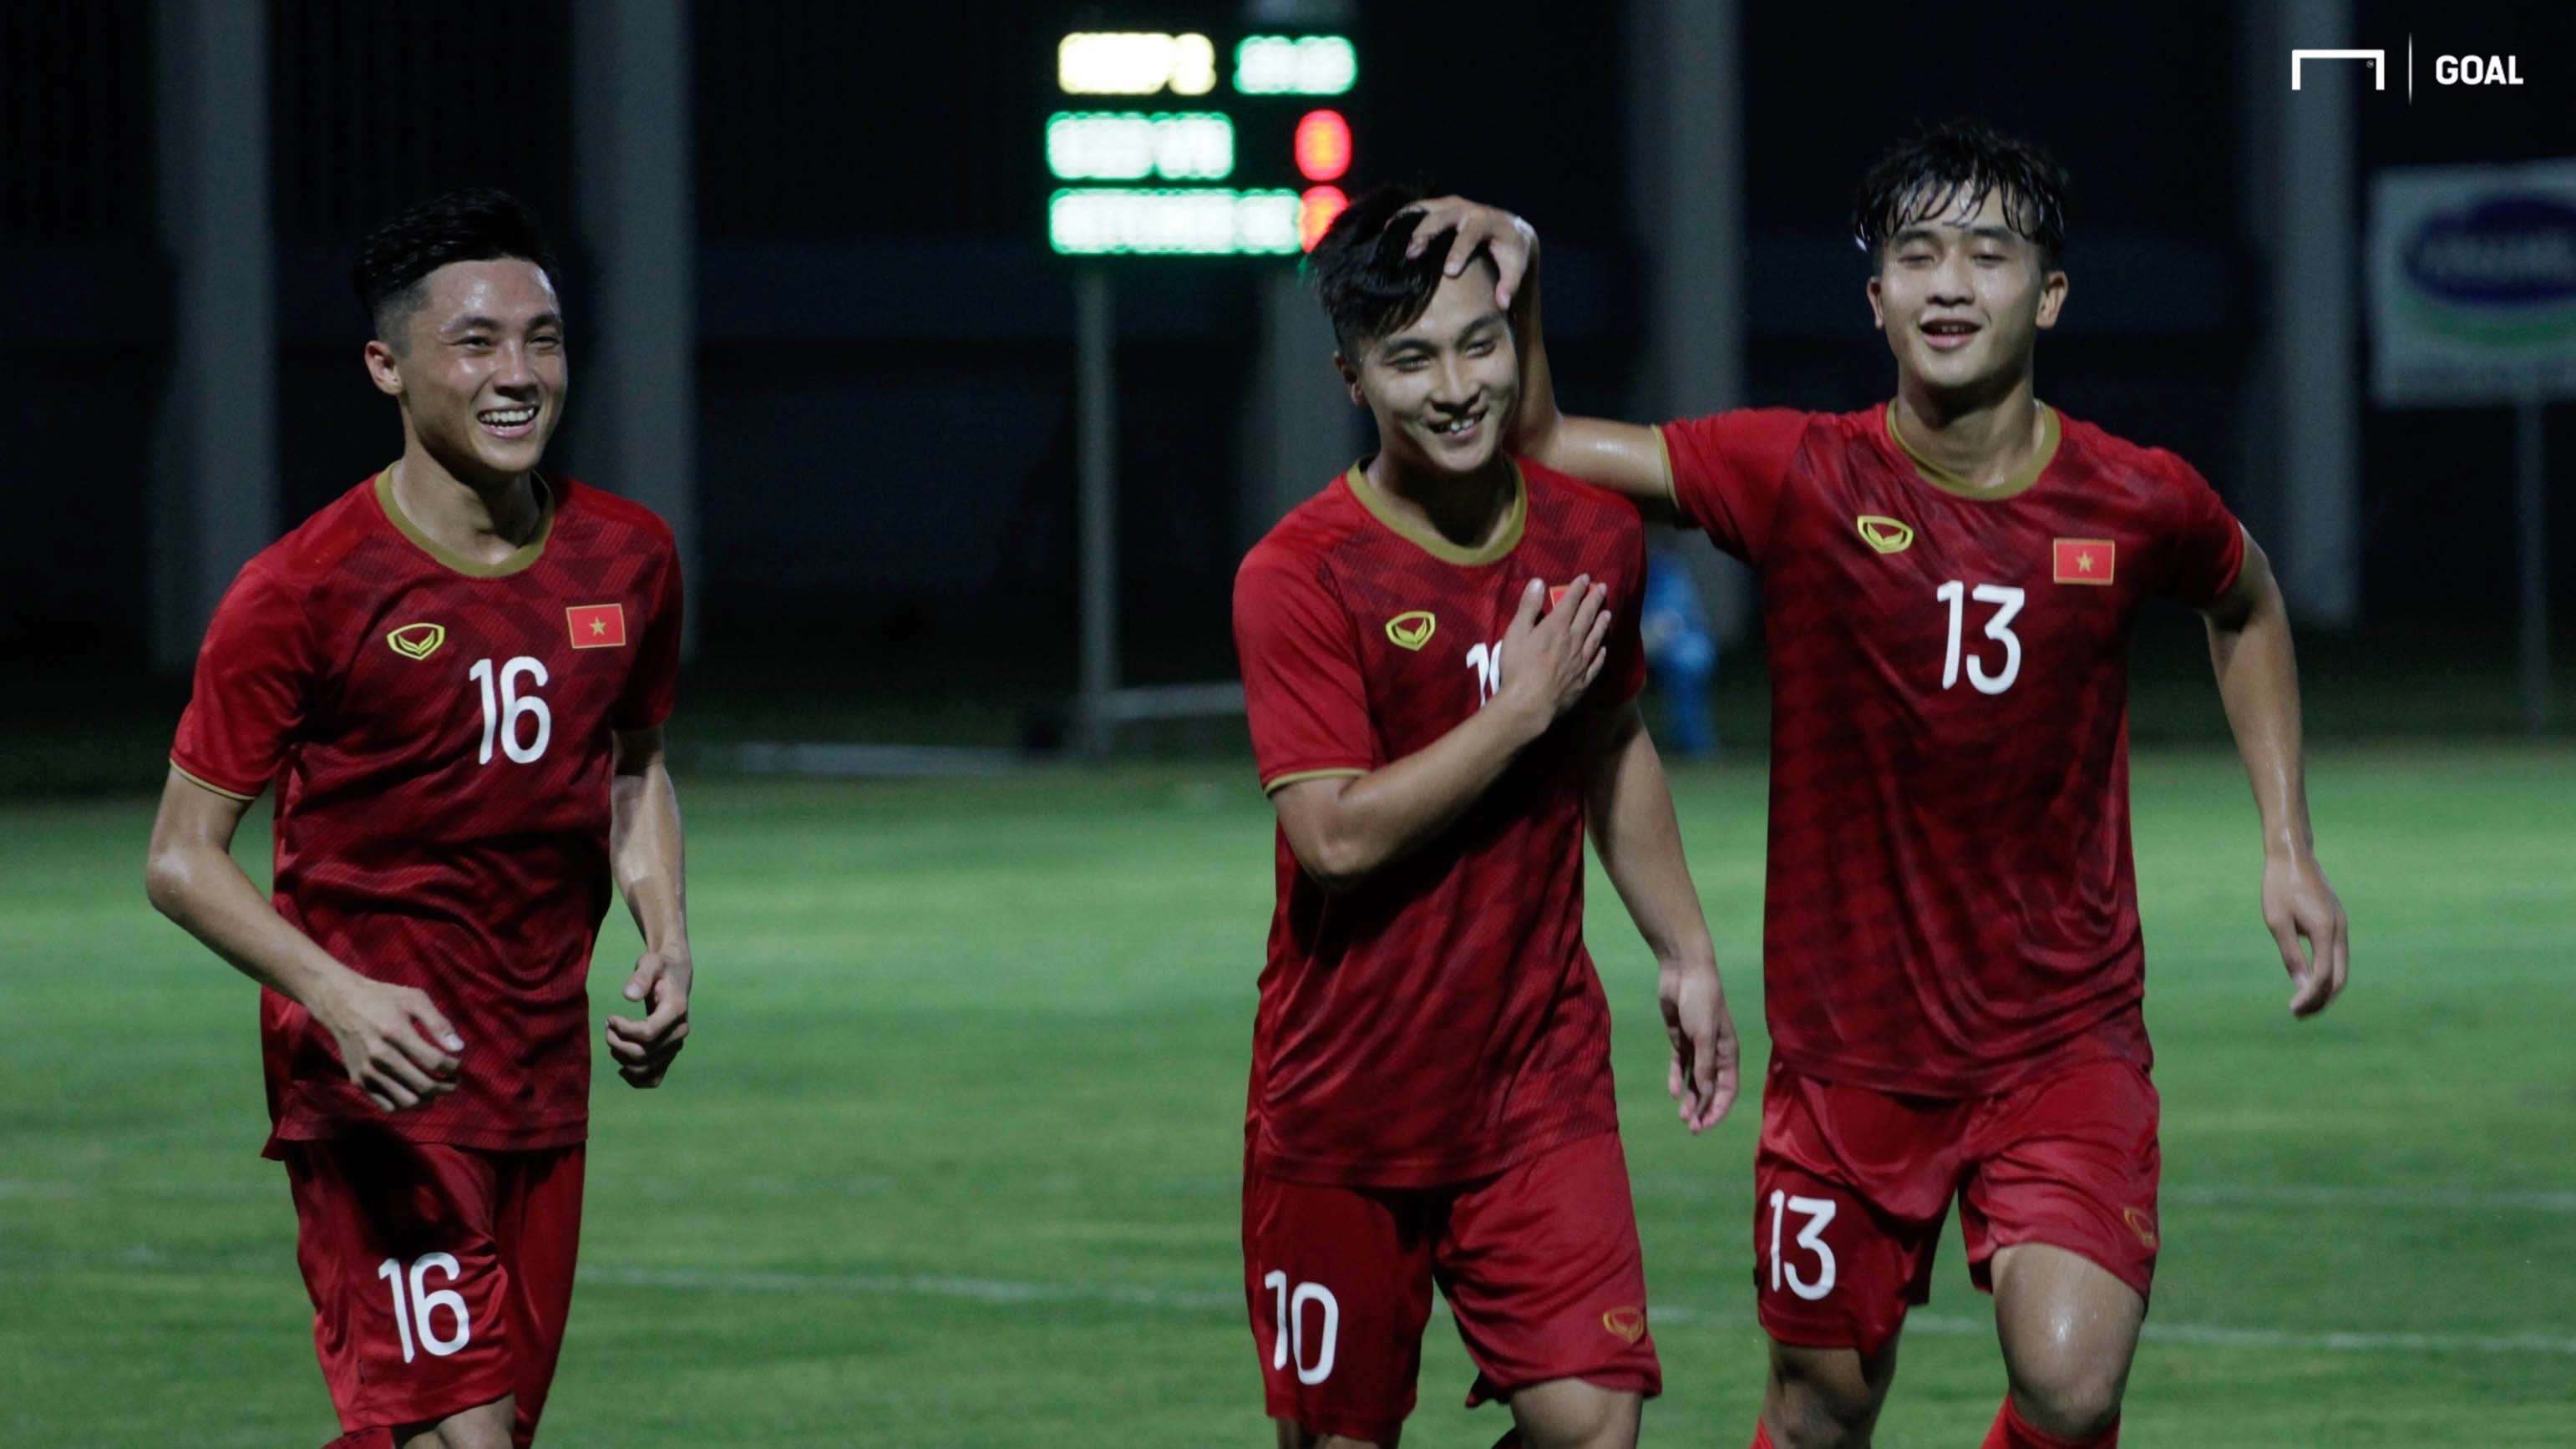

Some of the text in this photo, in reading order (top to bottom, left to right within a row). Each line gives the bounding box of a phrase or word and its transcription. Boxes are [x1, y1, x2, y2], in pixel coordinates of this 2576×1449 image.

[1936, 580, 2026, 695] 13
[469, 656, 551, 765] 16
[1770, 1188, 1836, 1300] 13
[378, 1252, 470, 1364] 16
[1265, 1269, 1339, 1385] 10
